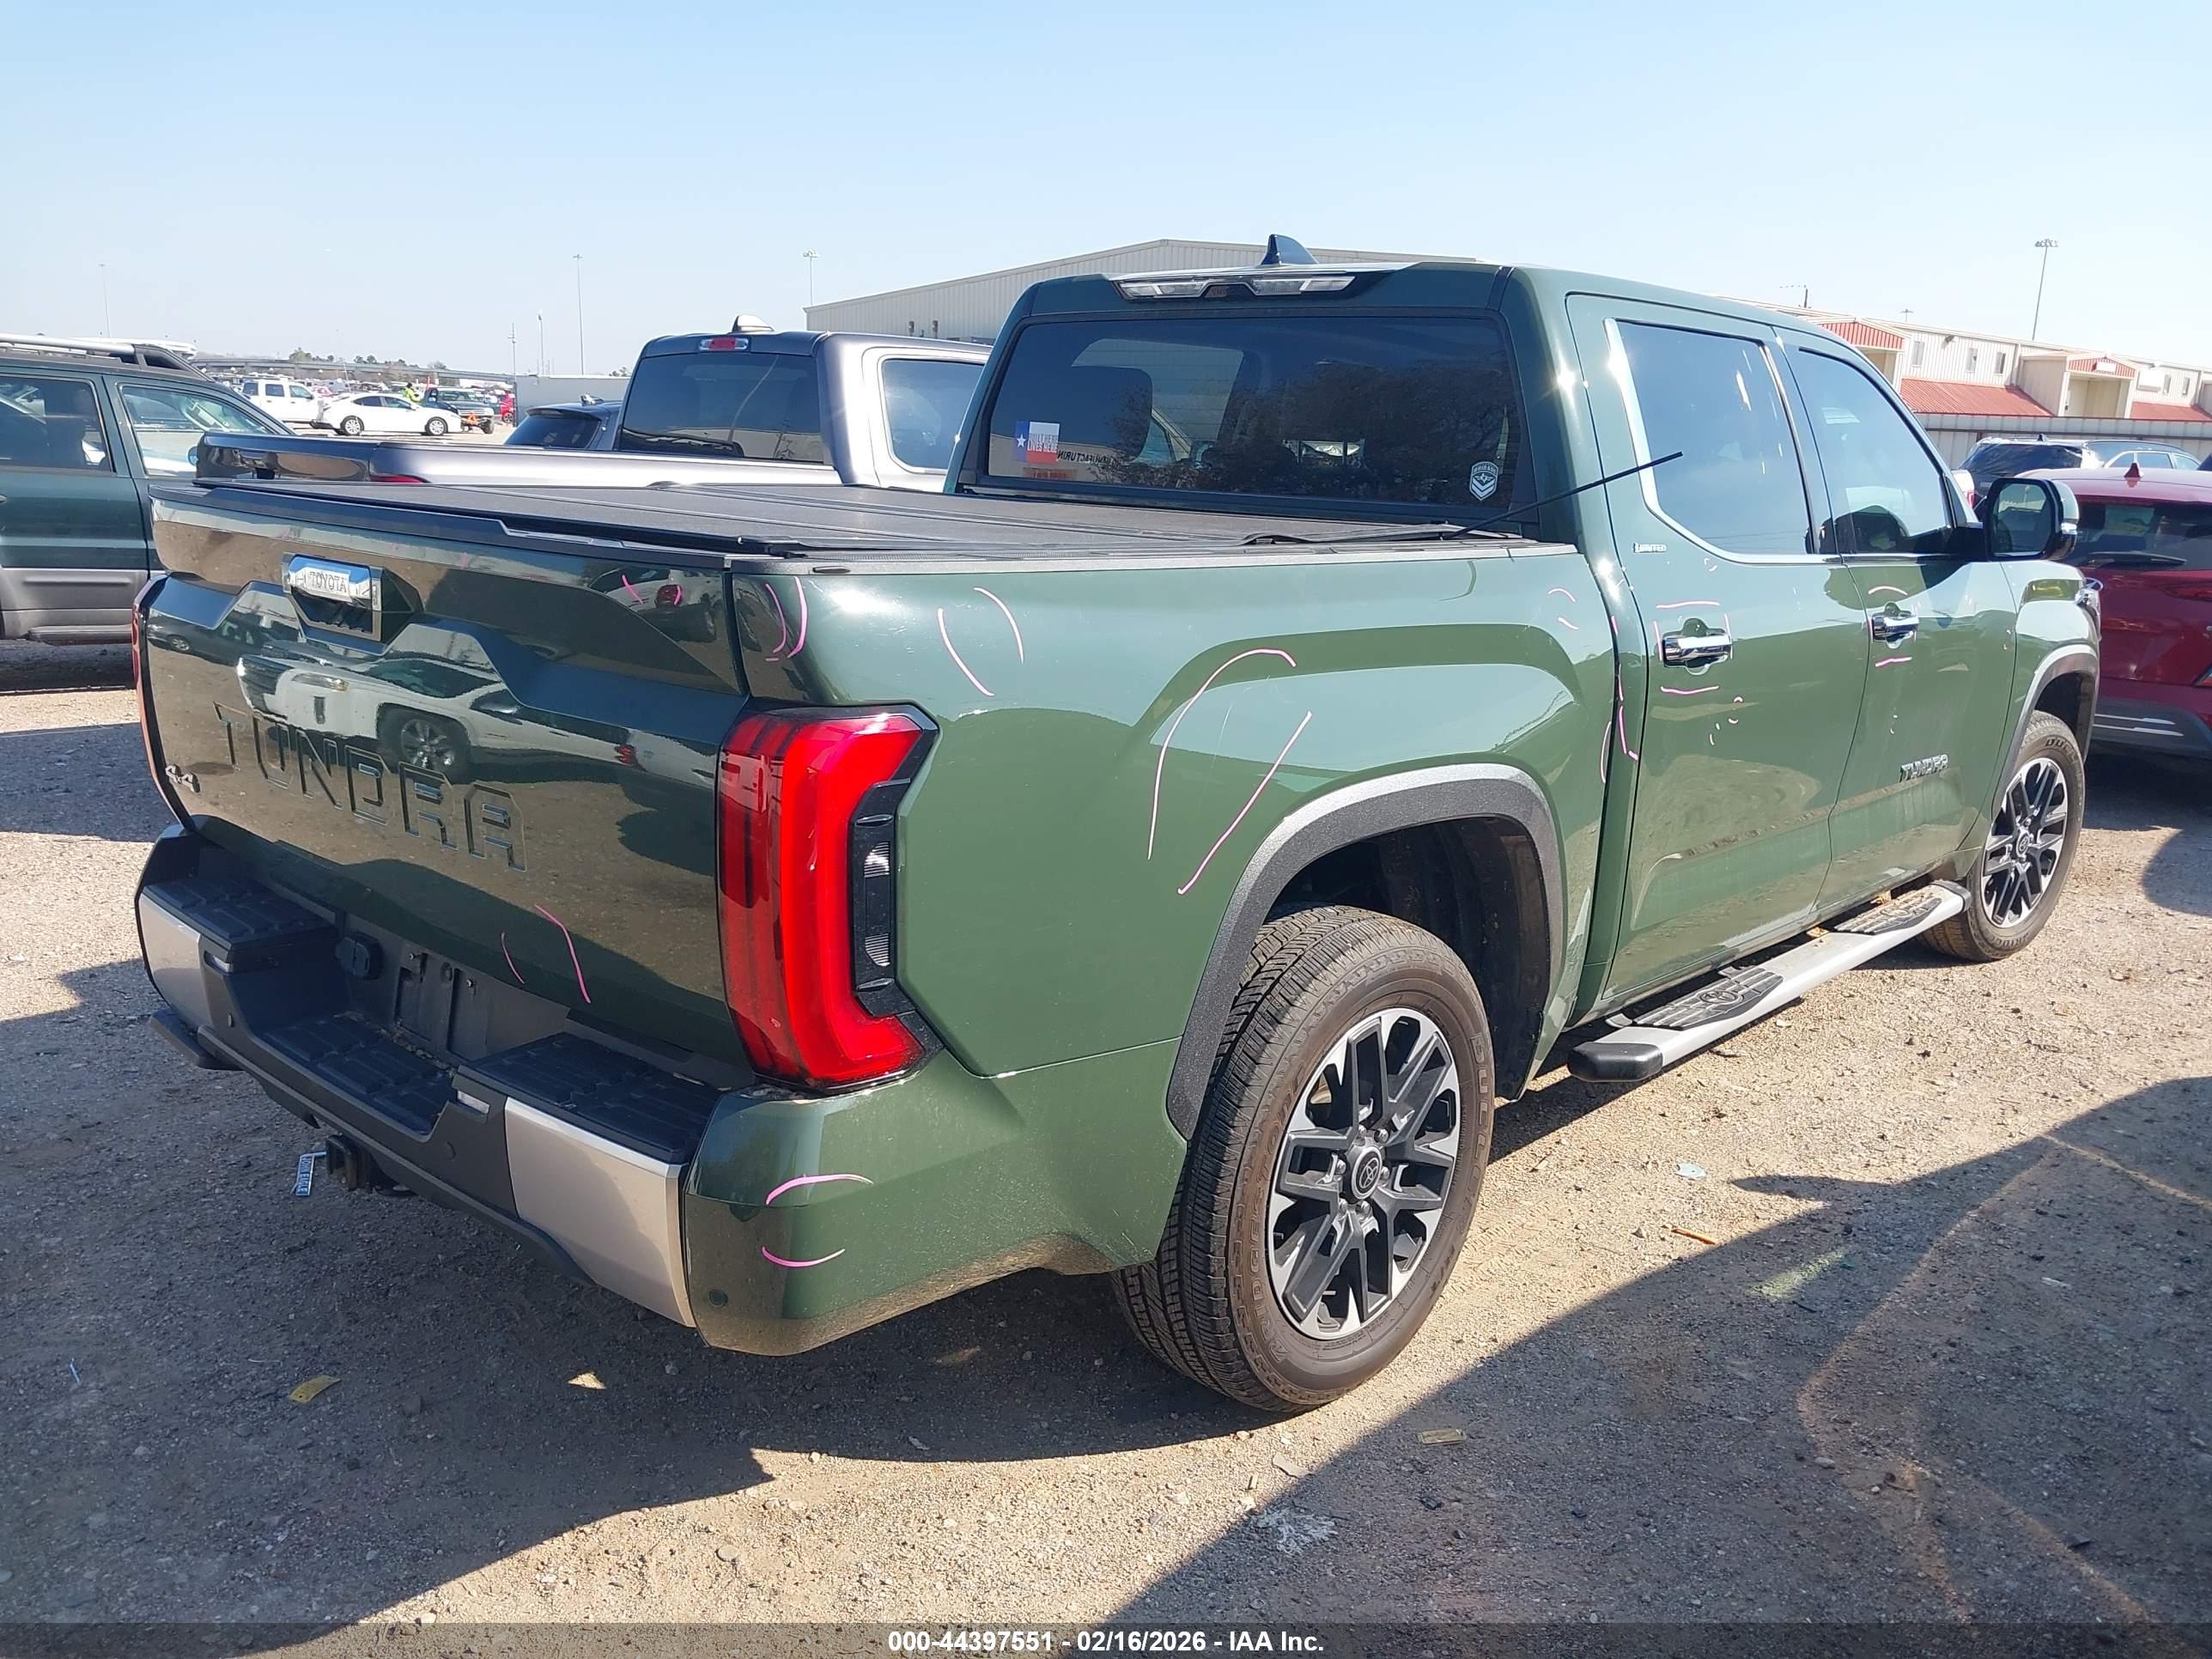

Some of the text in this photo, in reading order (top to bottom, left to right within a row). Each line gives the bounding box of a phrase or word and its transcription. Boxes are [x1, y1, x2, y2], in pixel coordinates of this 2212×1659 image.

[1027, 440, 1058, 453] LIVES HERE
[309, 571, 347, 593] TOYOTA
[213, 701, 528, 872] TUNDRA
